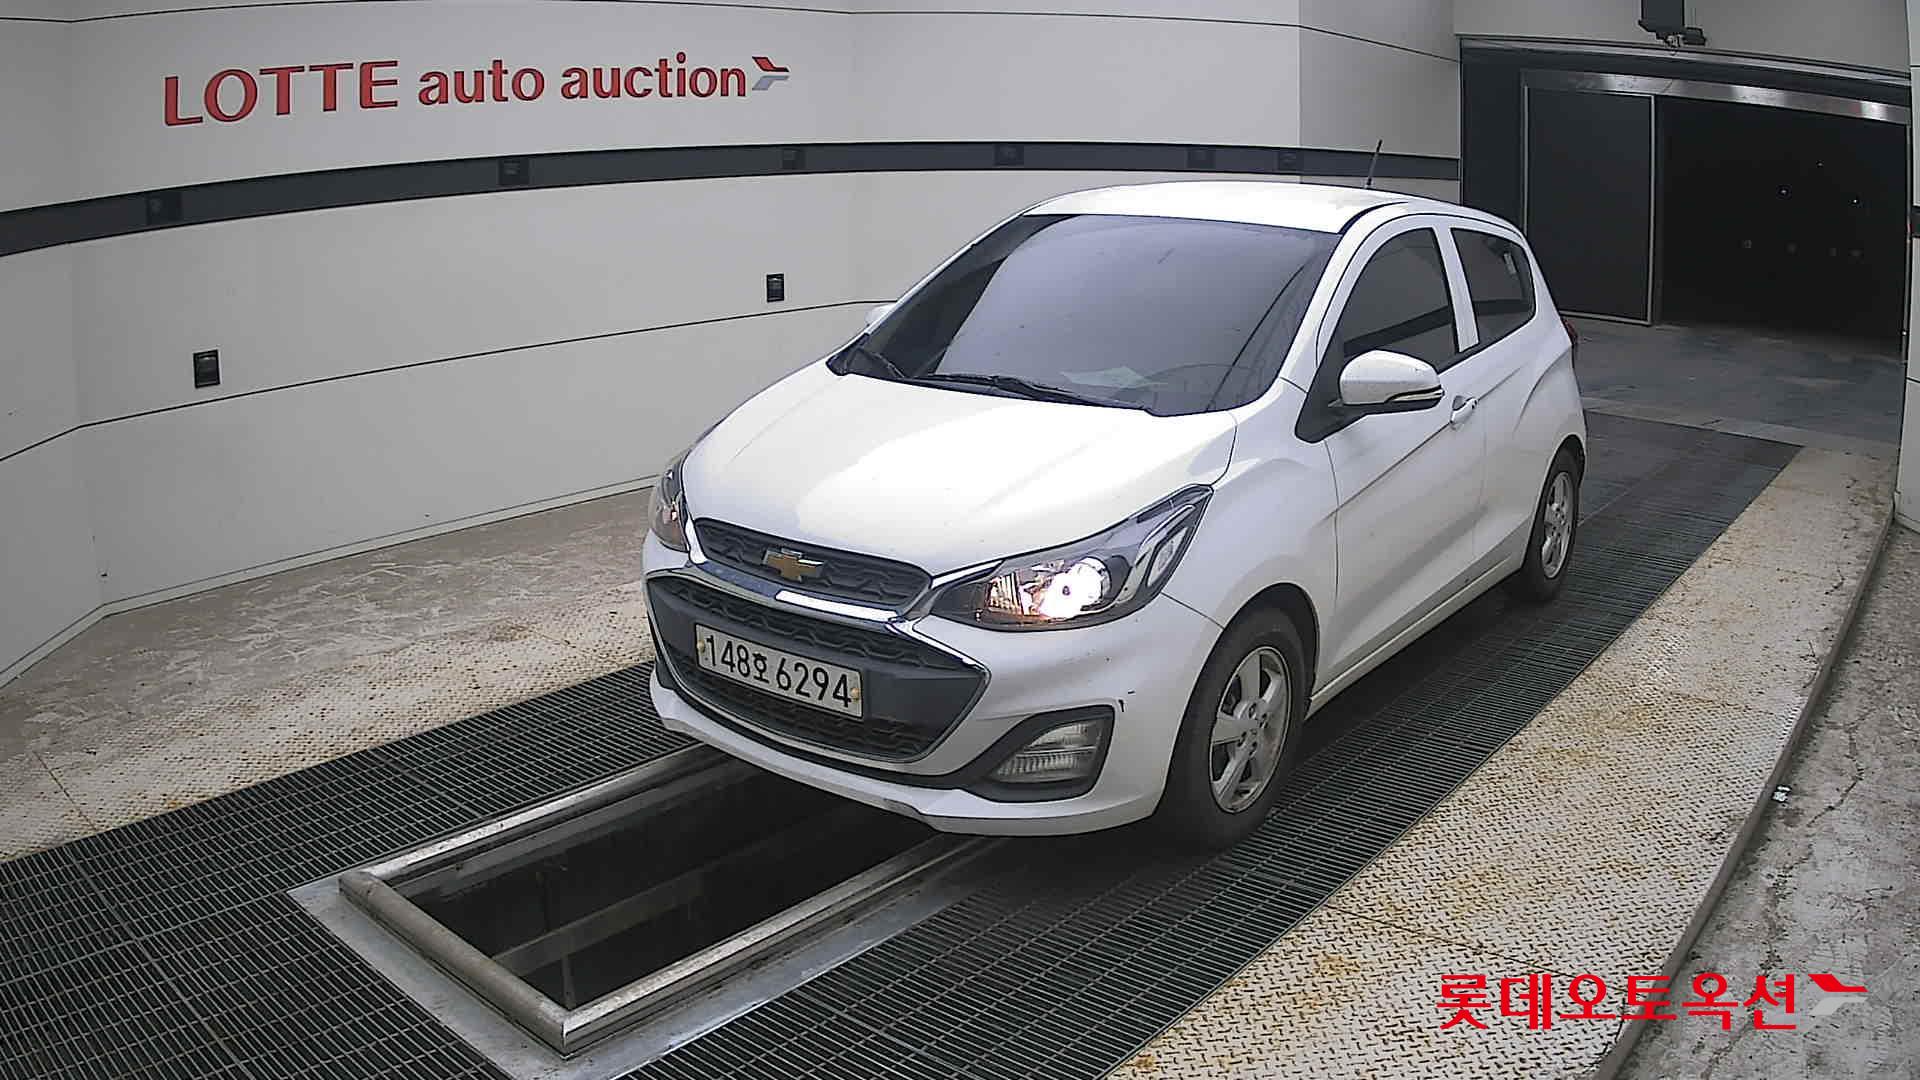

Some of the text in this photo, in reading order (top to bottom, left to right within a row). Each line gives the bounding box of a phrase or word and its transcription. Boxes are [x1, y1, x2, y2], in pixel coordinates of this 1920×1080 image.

[164, 51, 748, 126] LOTTE auto auction
[706, 634, 852, 708] 148호 6294
